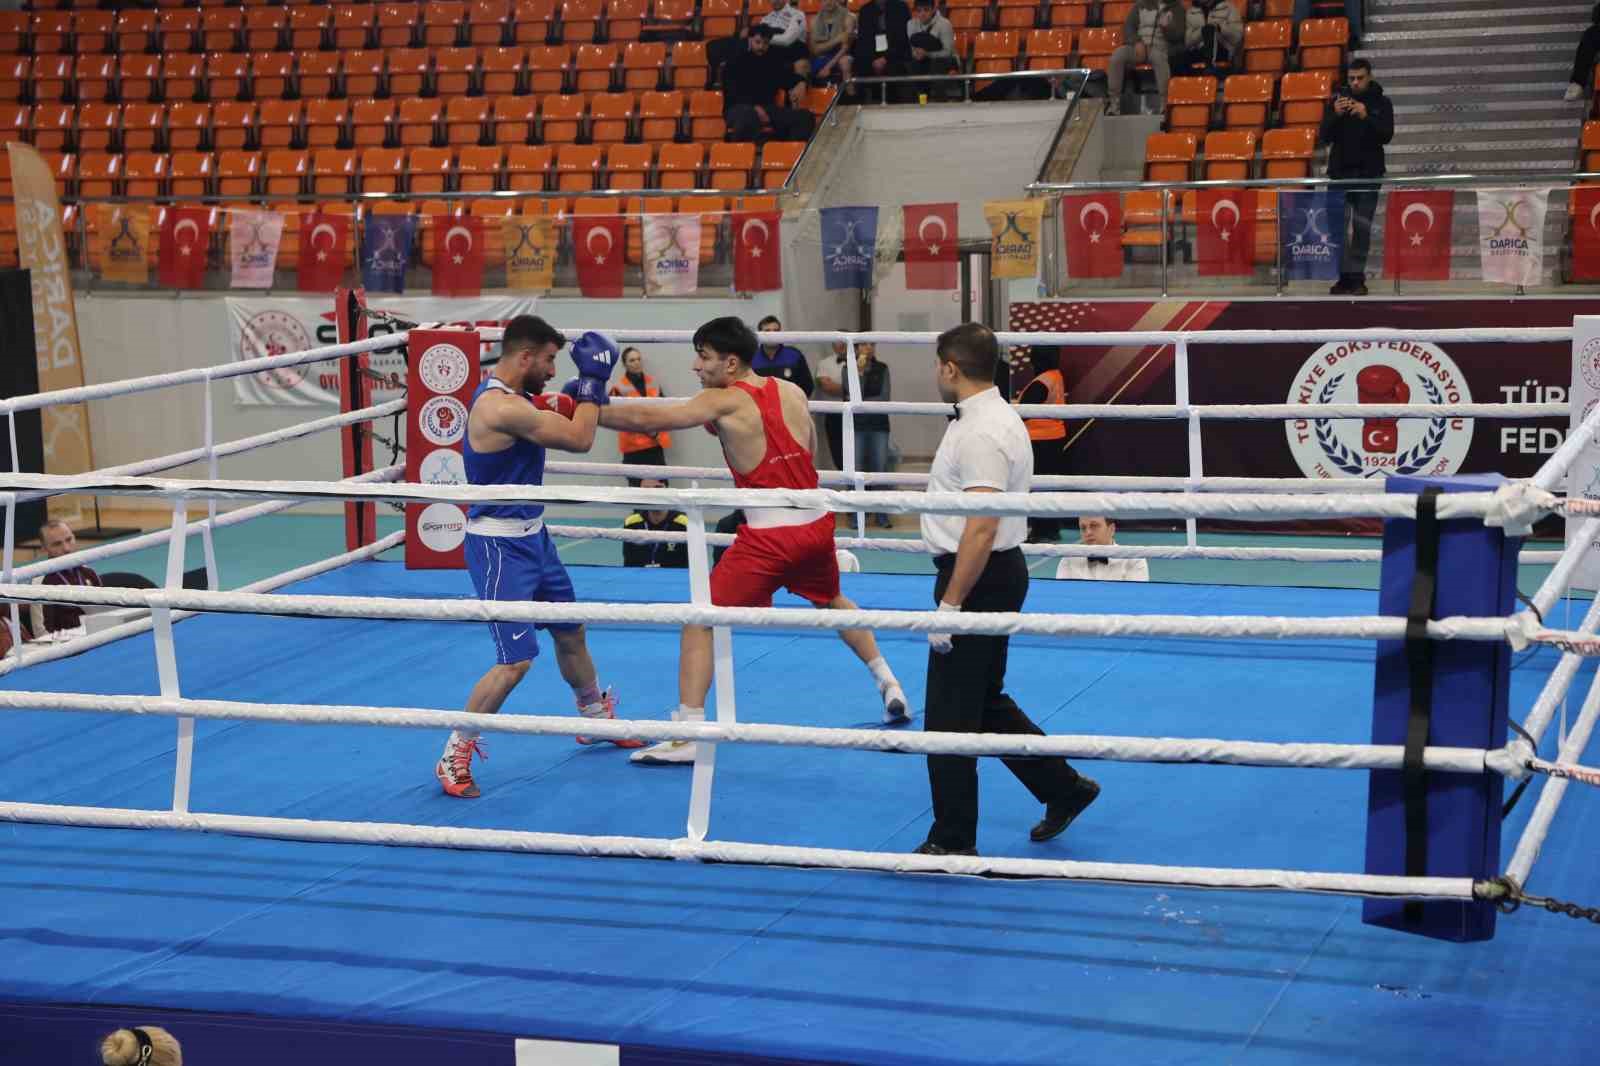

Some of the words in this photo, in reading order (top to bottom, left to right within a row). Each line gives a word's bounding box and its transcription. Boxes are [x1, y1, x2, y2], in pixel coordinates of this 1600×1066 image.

[1291, 244, 1330, 256] DARICA
[1490, 238, 1529, 249] DARICA
[1294, 364, 1326, 444] TÜKİYE
[1376, 339, 1464, 431] FEDERASYOU
[1499, 379, 1571, 404] TÜR
[1500, 427, 1570, 454] FED
[1363, 456, 1397, 467] 1924
